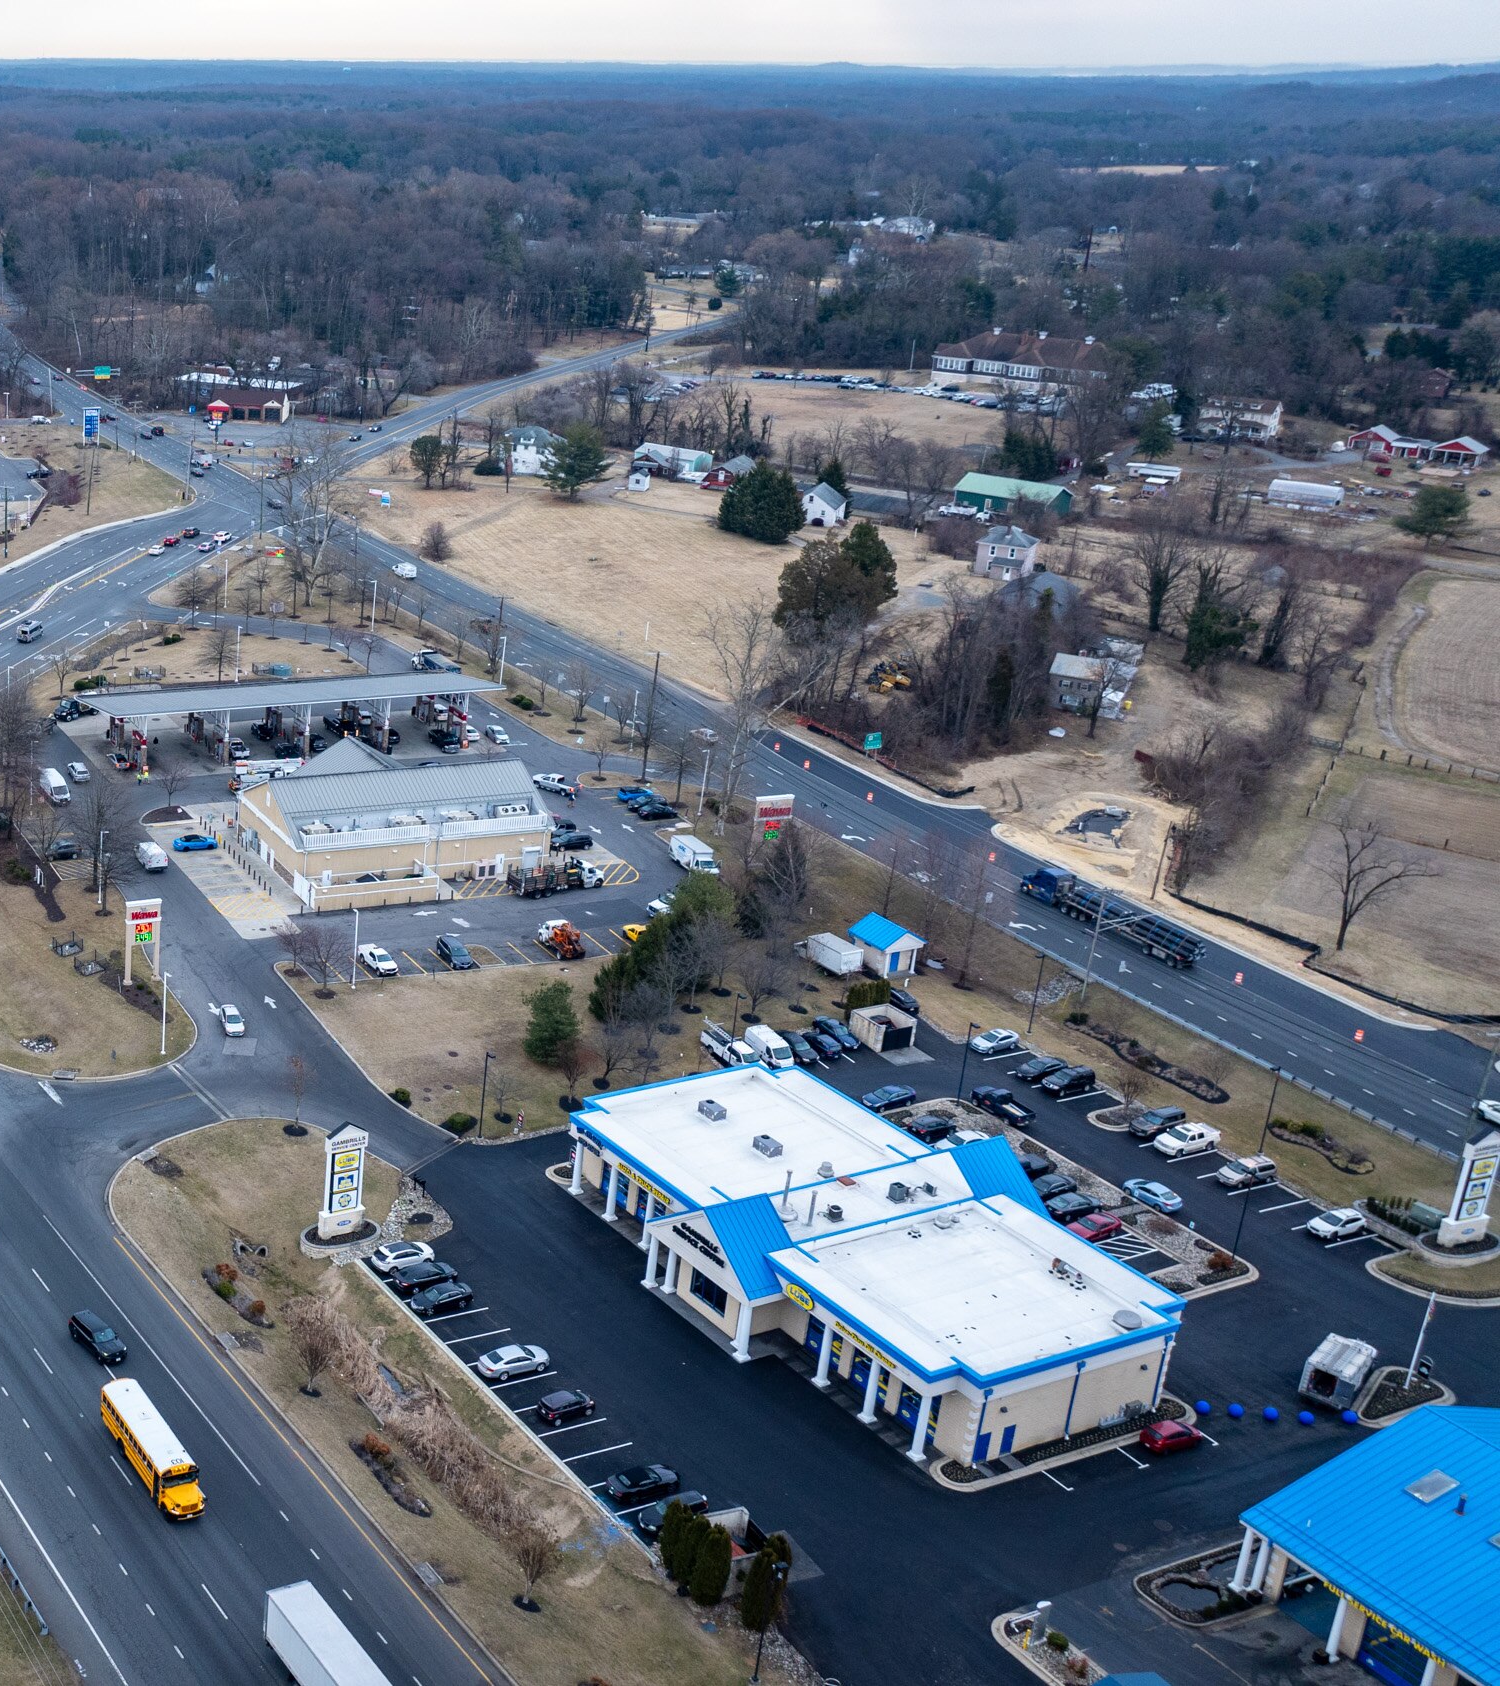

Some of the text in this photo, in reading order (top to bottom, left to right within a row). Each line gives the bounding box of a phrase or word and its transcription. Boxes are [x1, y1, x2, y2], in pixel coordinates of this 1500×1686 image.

[759, 807, 791, 818] Wawa
[131, 911, 157, 920] Wawa
[332, 1136, 366, 1147] GAMBRILLS
[672, 1225, 725, 1268] SERVICE CENTER
[680, 1222, 720, 1253] GAMBRILLS
[790, 1286, 809, 1305] LUBE
[1323, 1580, 1446, 1669] FULL SERVICE CAR WASH
